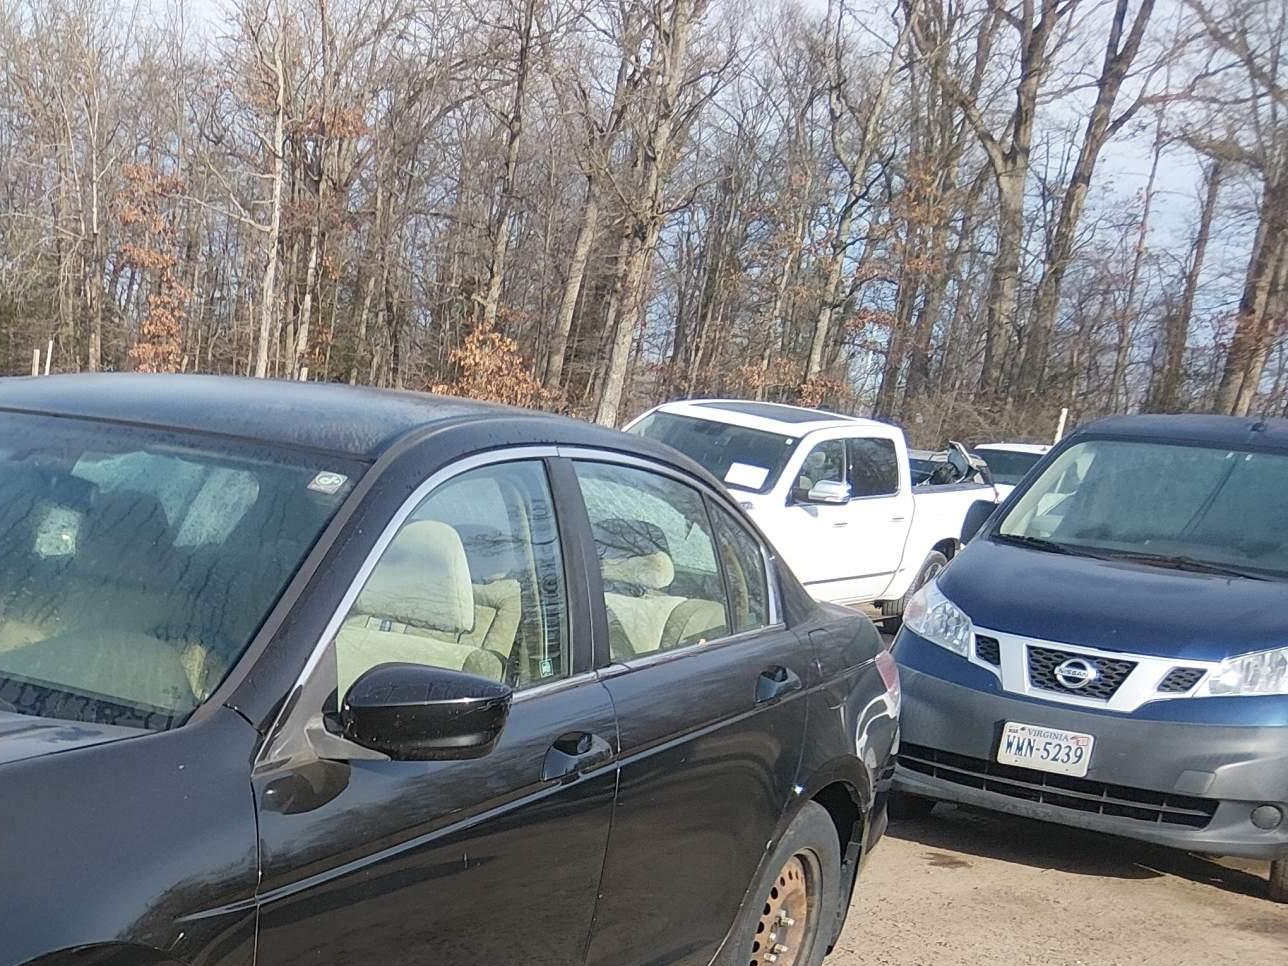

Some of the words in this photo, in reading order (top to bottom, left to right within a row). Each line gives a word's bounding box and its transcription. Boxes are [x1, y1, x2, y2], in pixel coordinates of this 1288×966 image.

[1058, 667, 1089, 679] NISSAN
[1028, 728, 1069, 743] VIRGINIA
[1005, 734, 1084, 765] WMN-5239
